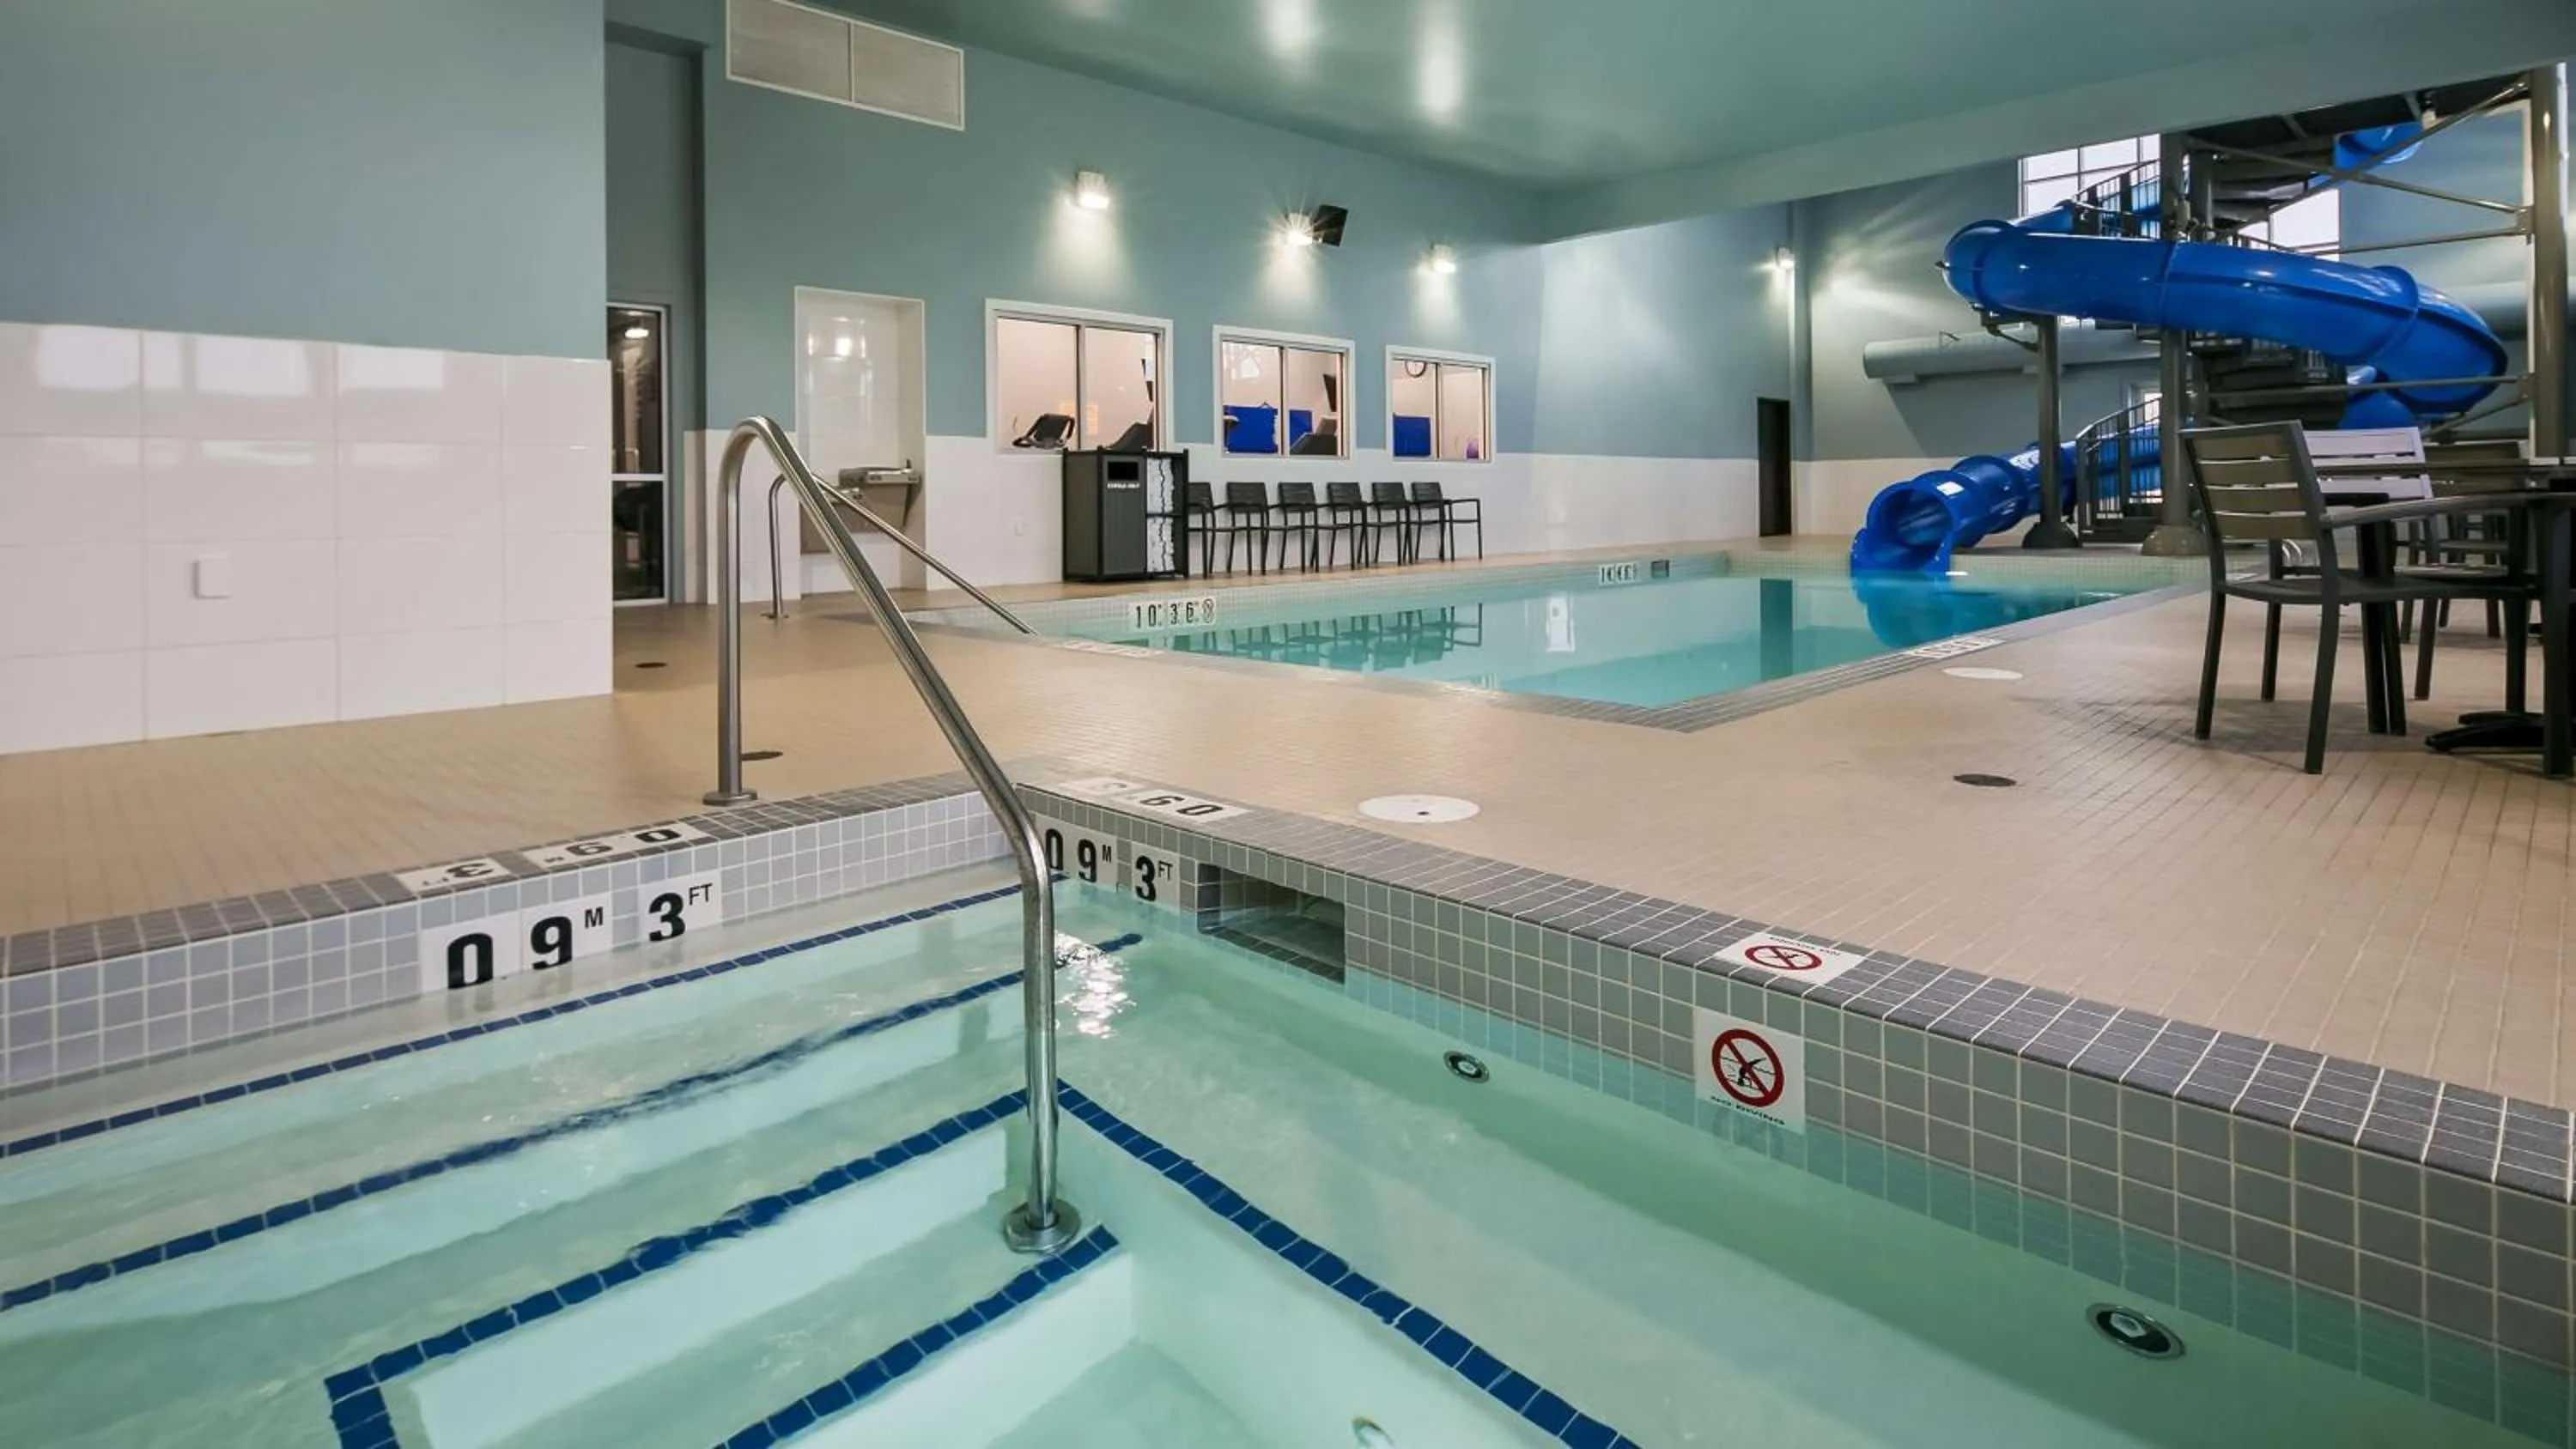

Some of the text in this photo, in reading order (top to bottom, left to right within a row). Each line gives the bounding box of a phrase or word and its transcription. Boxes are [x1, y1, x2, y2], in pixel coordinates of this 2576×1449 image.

[1102, 844, 1112, 864] M
[1135, 855, 1157, 902] 3
[1158, 859, 1173, 882] FT
[585, 906, 605, 931] M
[648, 891, 686, 943] 3
[689, 882, 714, 906] FT
